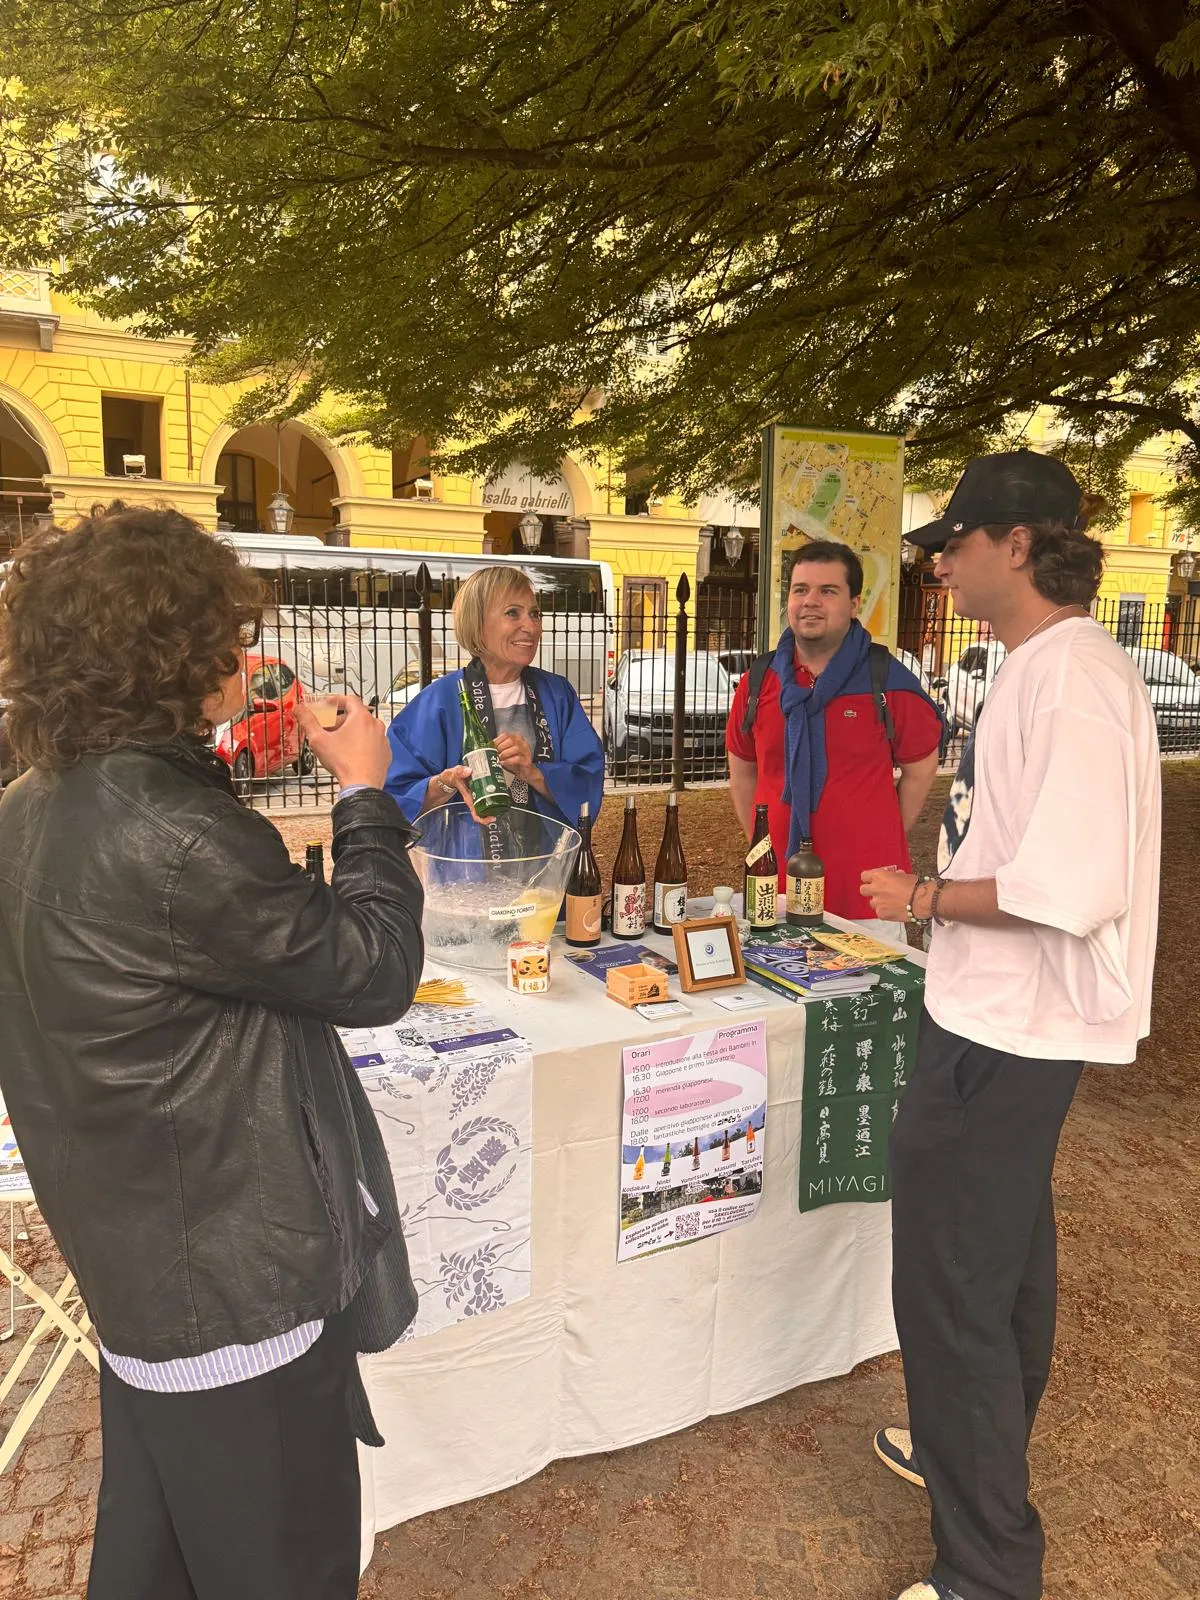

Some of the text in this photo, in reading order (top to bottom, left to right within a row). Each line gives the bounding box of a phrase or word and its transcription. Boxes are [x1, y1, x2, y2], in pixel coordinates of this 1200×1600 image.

[520, 490, 570, 510] gabrielli
[472, 681, 488, 711] Sake
[488, 822, 504, 871] ciation
[718, 1025, 758, 1039] Programma
[631, 1048, 651, 1059] Orari
[655, 1085, 681, 1095] merenda
[808, 1175, 885, 1199] MIYAGI
